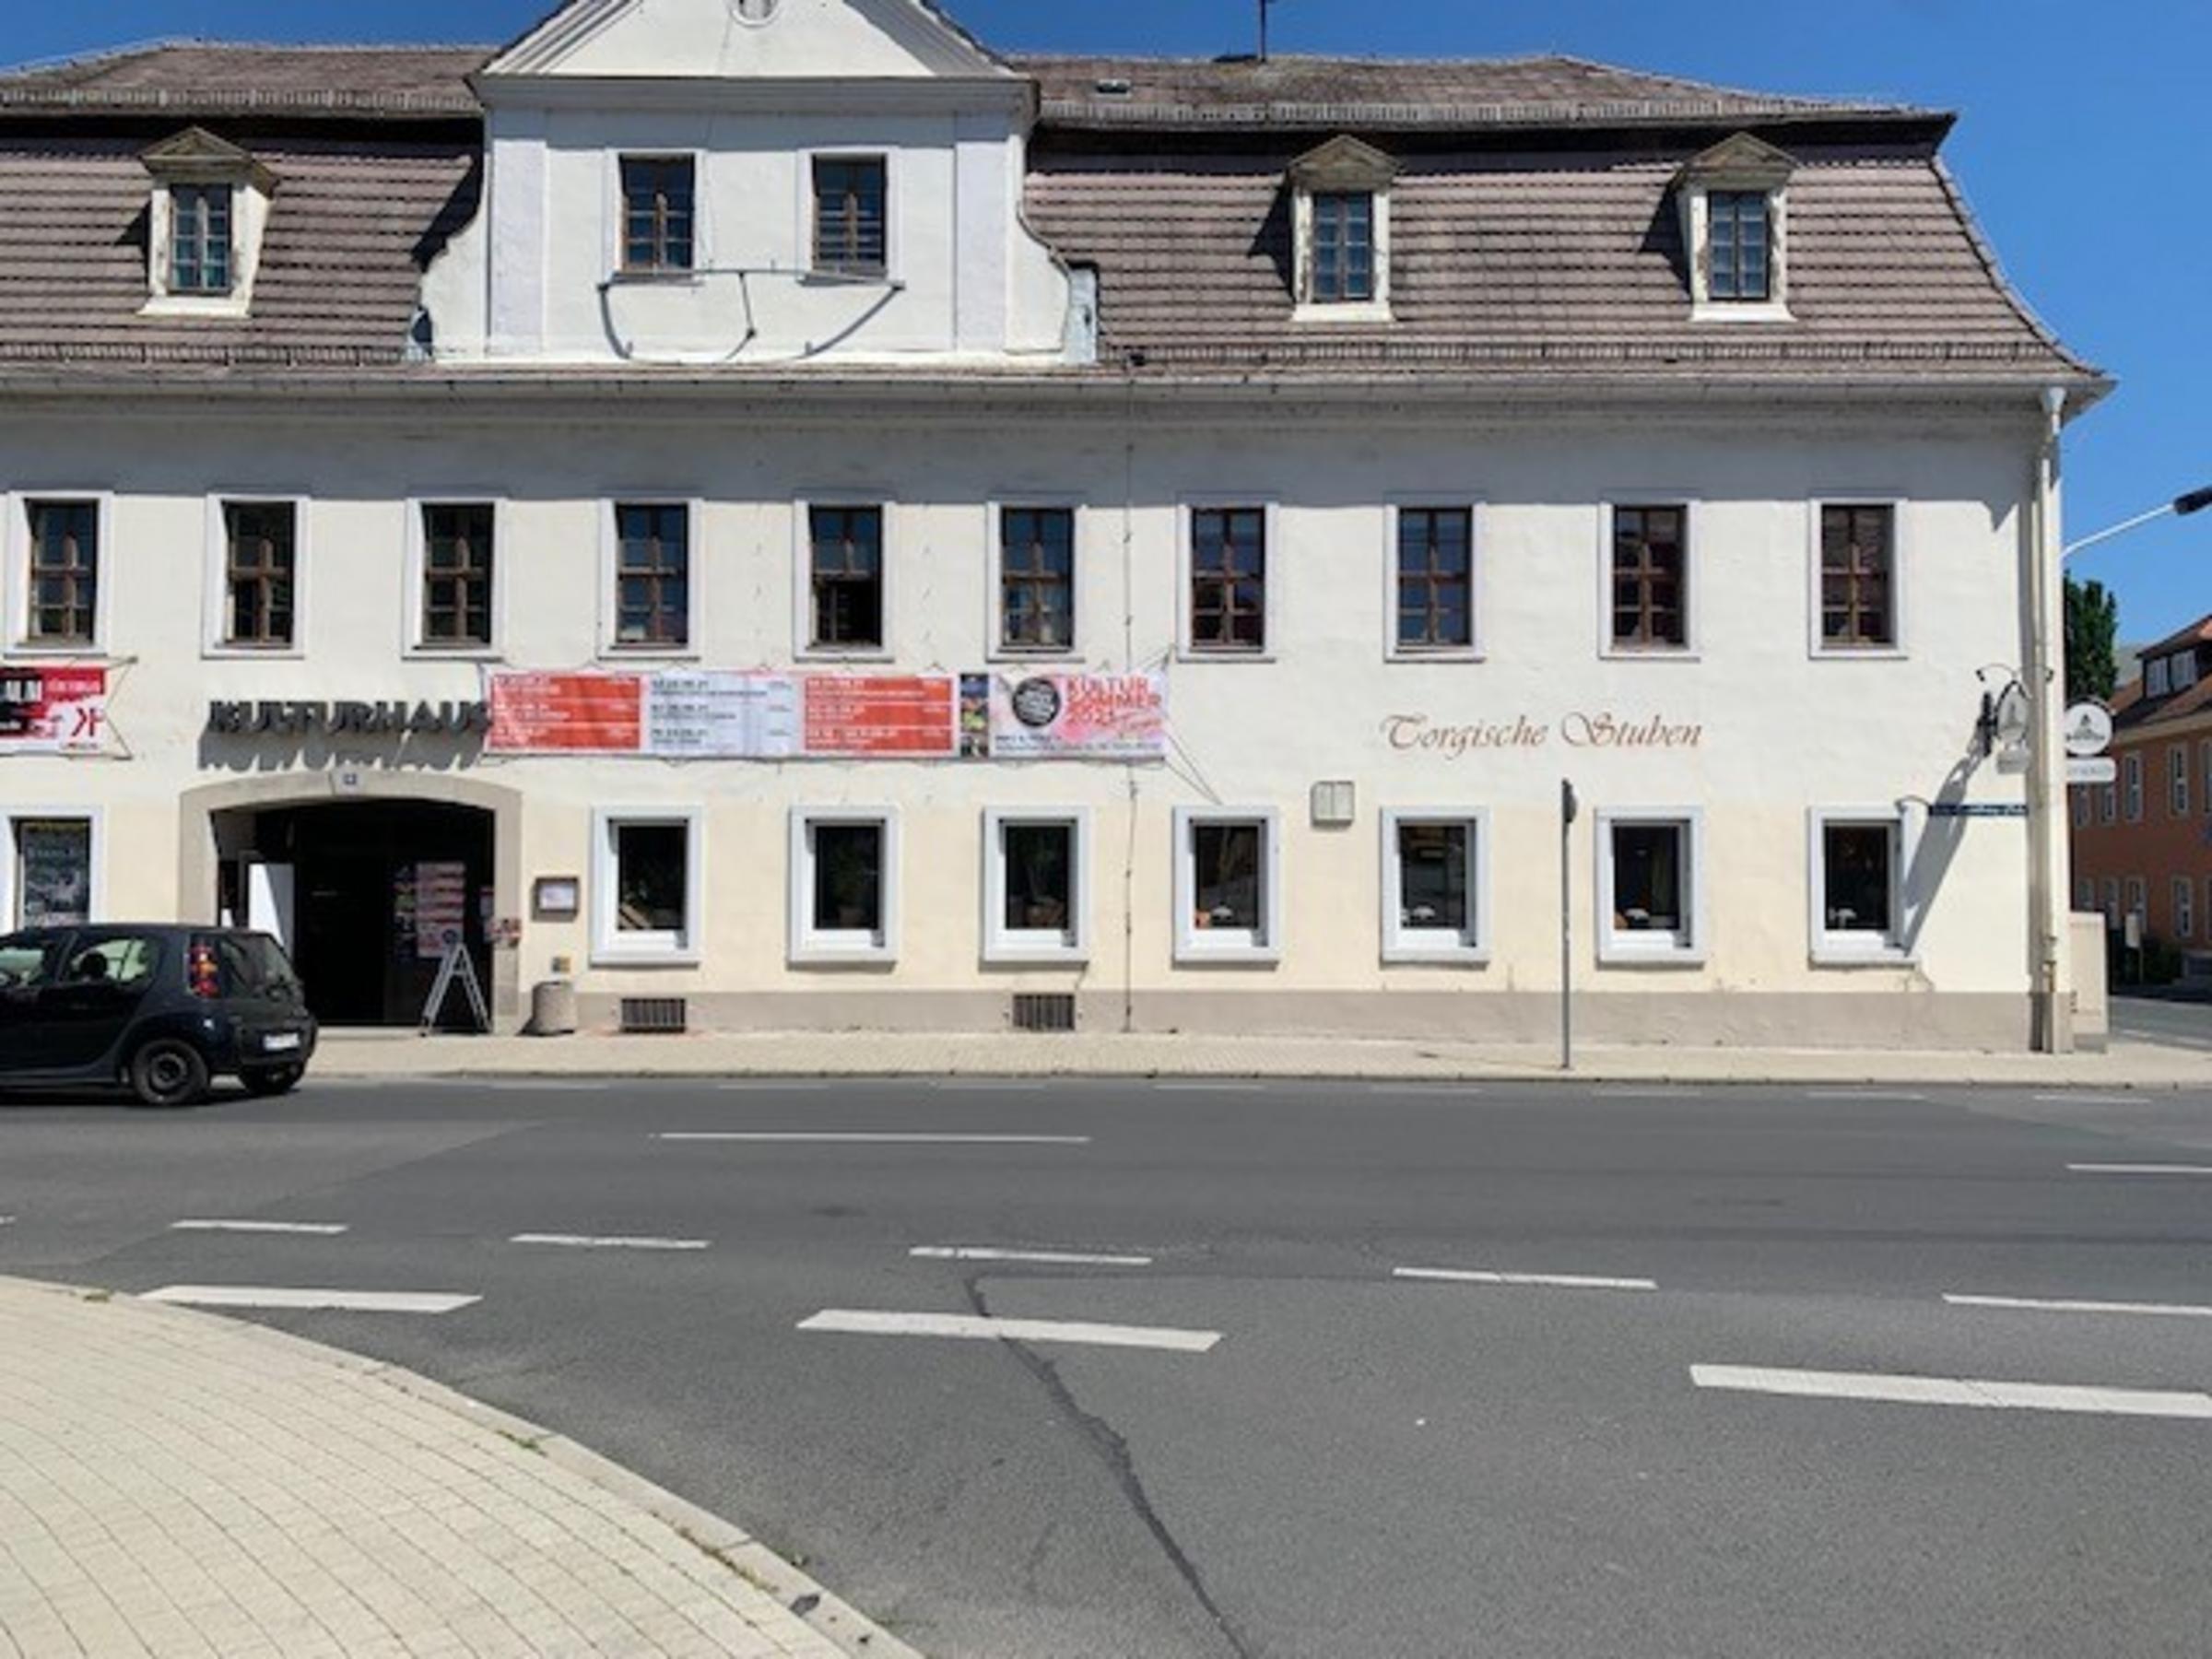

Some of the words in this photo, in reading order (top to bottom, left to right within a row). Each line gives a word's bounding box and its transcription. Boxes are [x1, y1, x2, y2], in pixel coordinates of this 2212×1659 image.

[208, 700, 493, 732] KULTURHAUS
[1381, 713, 1549, 760] Torgische
[1560, 712, 1703, 748] Stuben
